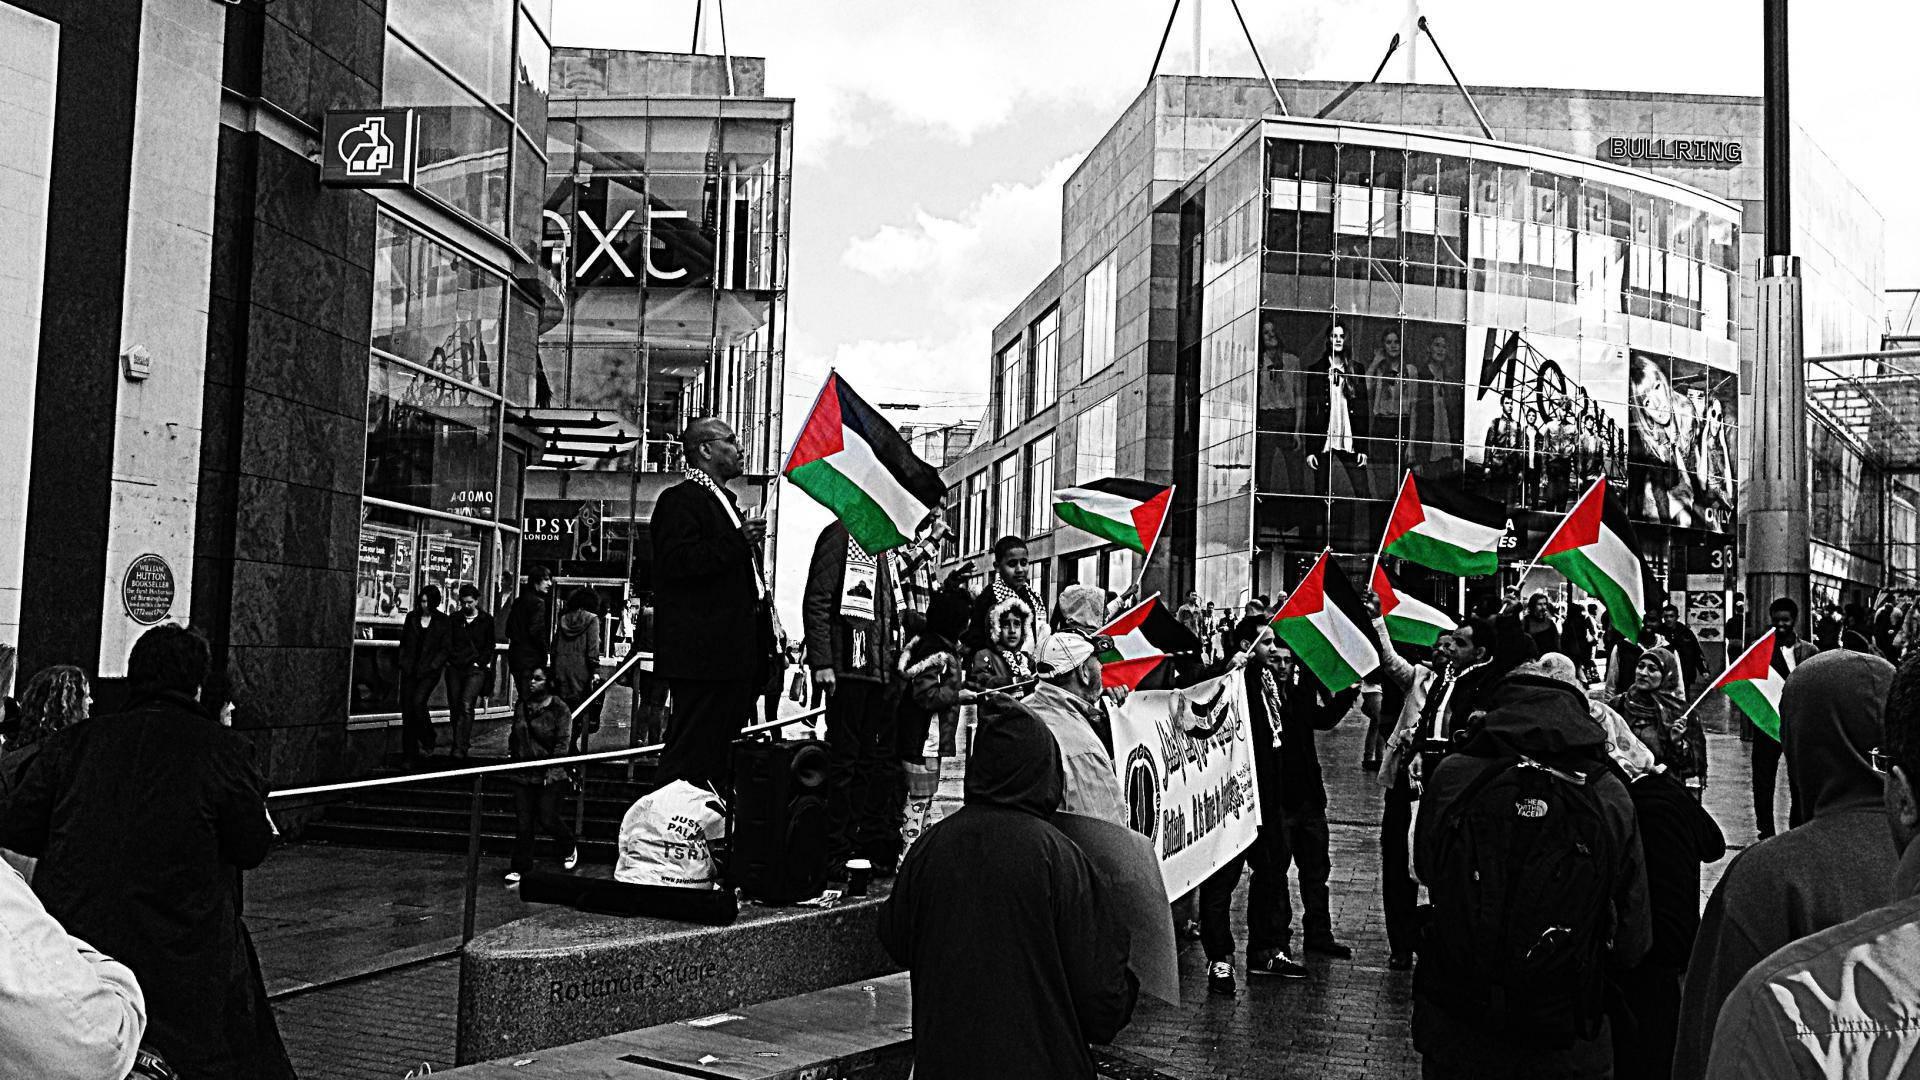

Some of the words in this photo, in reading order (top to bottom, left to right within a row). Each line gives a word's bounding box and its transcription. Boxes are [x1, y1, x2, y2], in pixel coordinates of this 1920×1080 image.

[1609, 136, 1743, 163] BULLRING
[1705, 507, 1731, 525] ONLY
[139, 564, 164, 572] WILLIAM
[136, 572, 166, 580] HUTTON
[131, 580, 169, 588] BOOKSELLER
[550, 970, 644, 1003] Rotunda
[650, 961, 716, 990] Square
